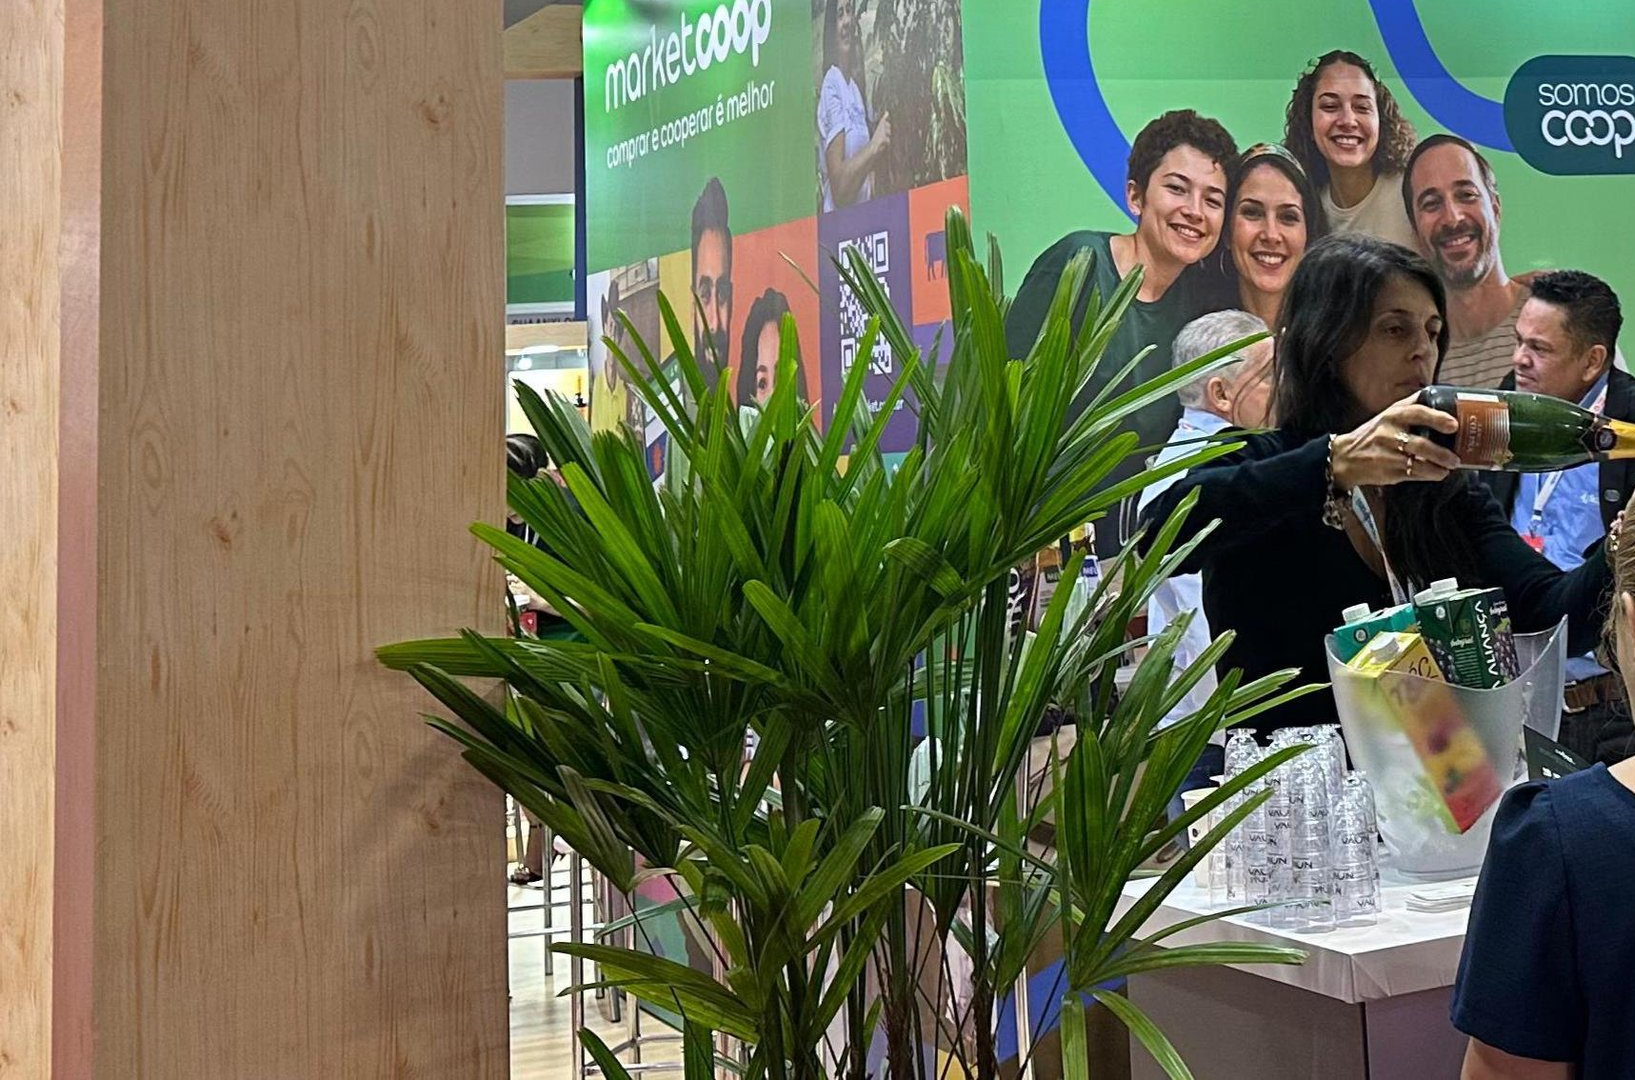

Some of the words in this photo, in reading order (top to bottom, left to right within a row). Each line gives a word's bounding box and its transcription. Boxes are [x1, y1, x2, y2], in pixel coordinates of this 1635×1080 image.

[606, 130, 650, 169] comprar
[651, 127, 660, 152] e
[660, 105, 713, 149] cooperar
[715, 93, 725, 127] é
[726, 79, 776, 123] melhor
[1538, 82, 1635, 107] somos
[1474, 600, 1500, 676] ALIANÇA
